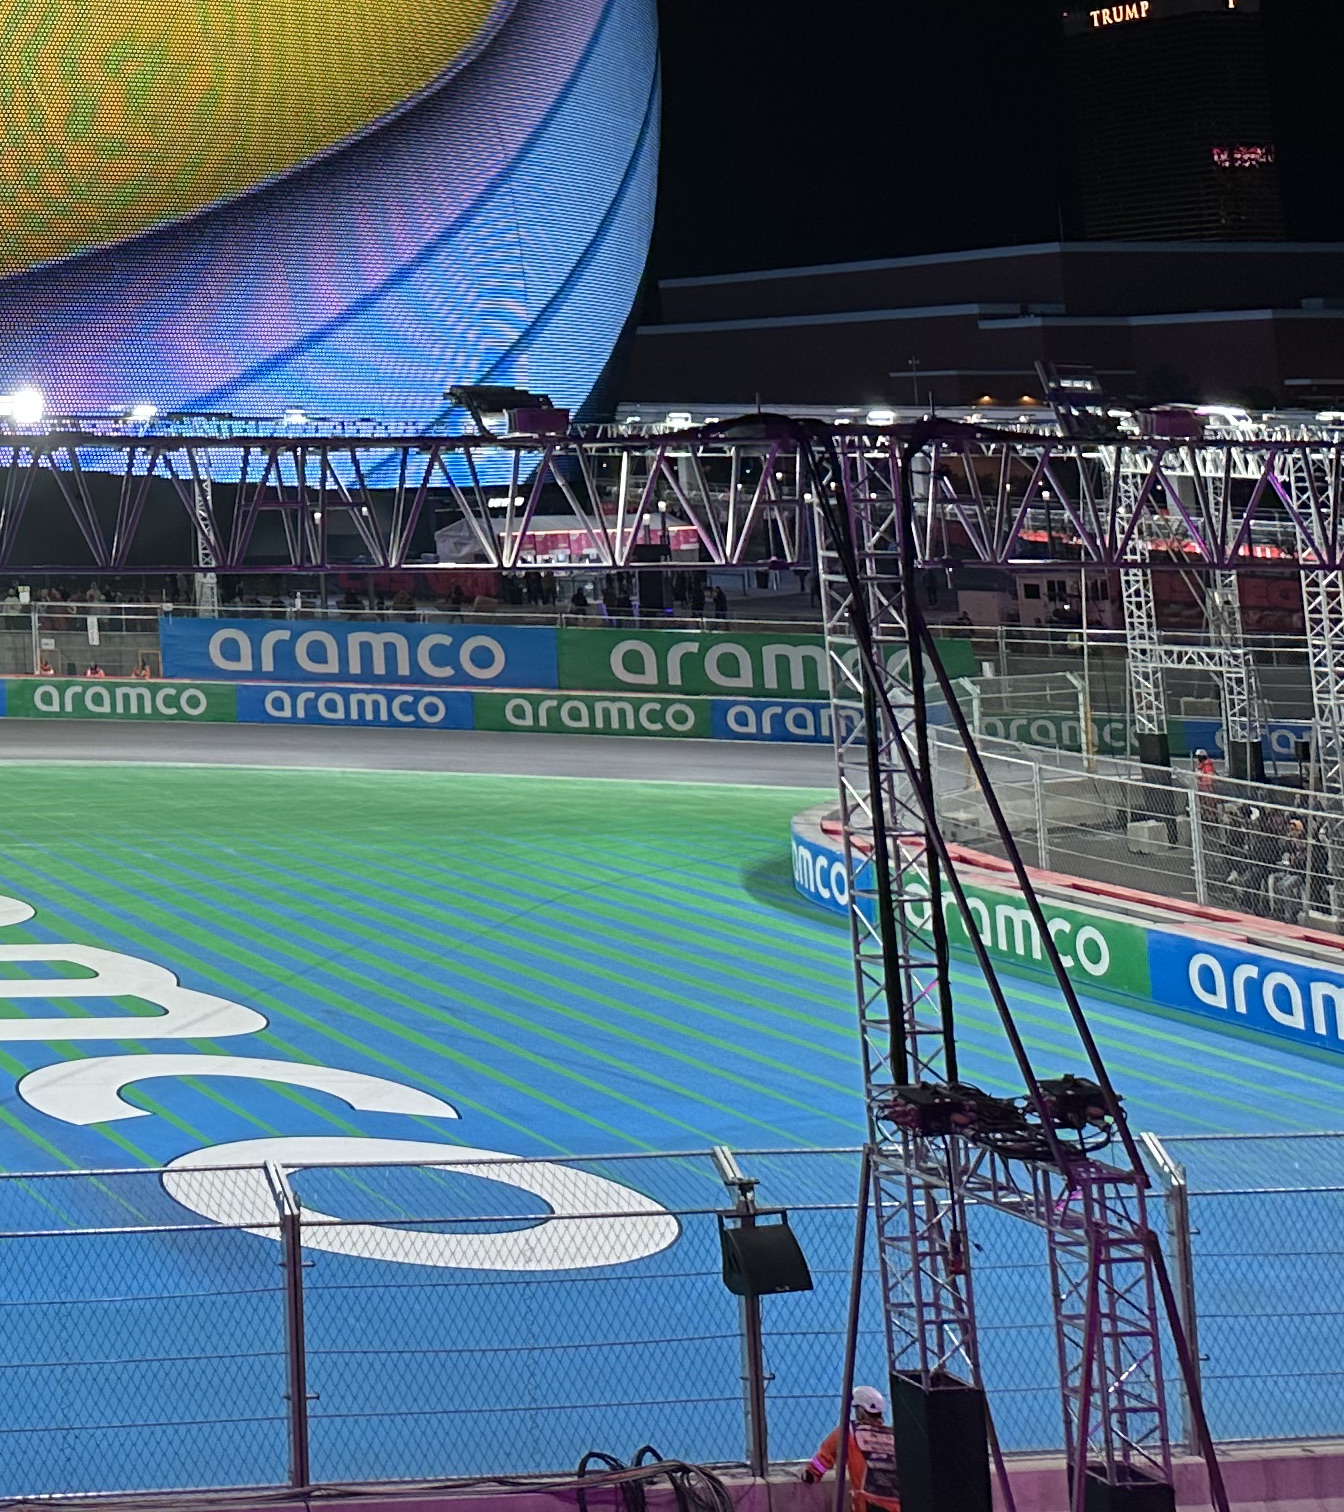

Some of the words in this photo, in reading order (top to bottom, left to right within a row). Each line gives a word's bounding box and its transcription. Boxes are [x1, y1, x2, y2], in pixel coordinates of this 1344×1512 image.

[1089, 0, 1150, 27] TRUMP
[209, 628, 505, 680] aramco
[34, 684, 208, 716] aramco
[264, 690, 446, 724] aramco
[505, 697, 696, 732] aramco
